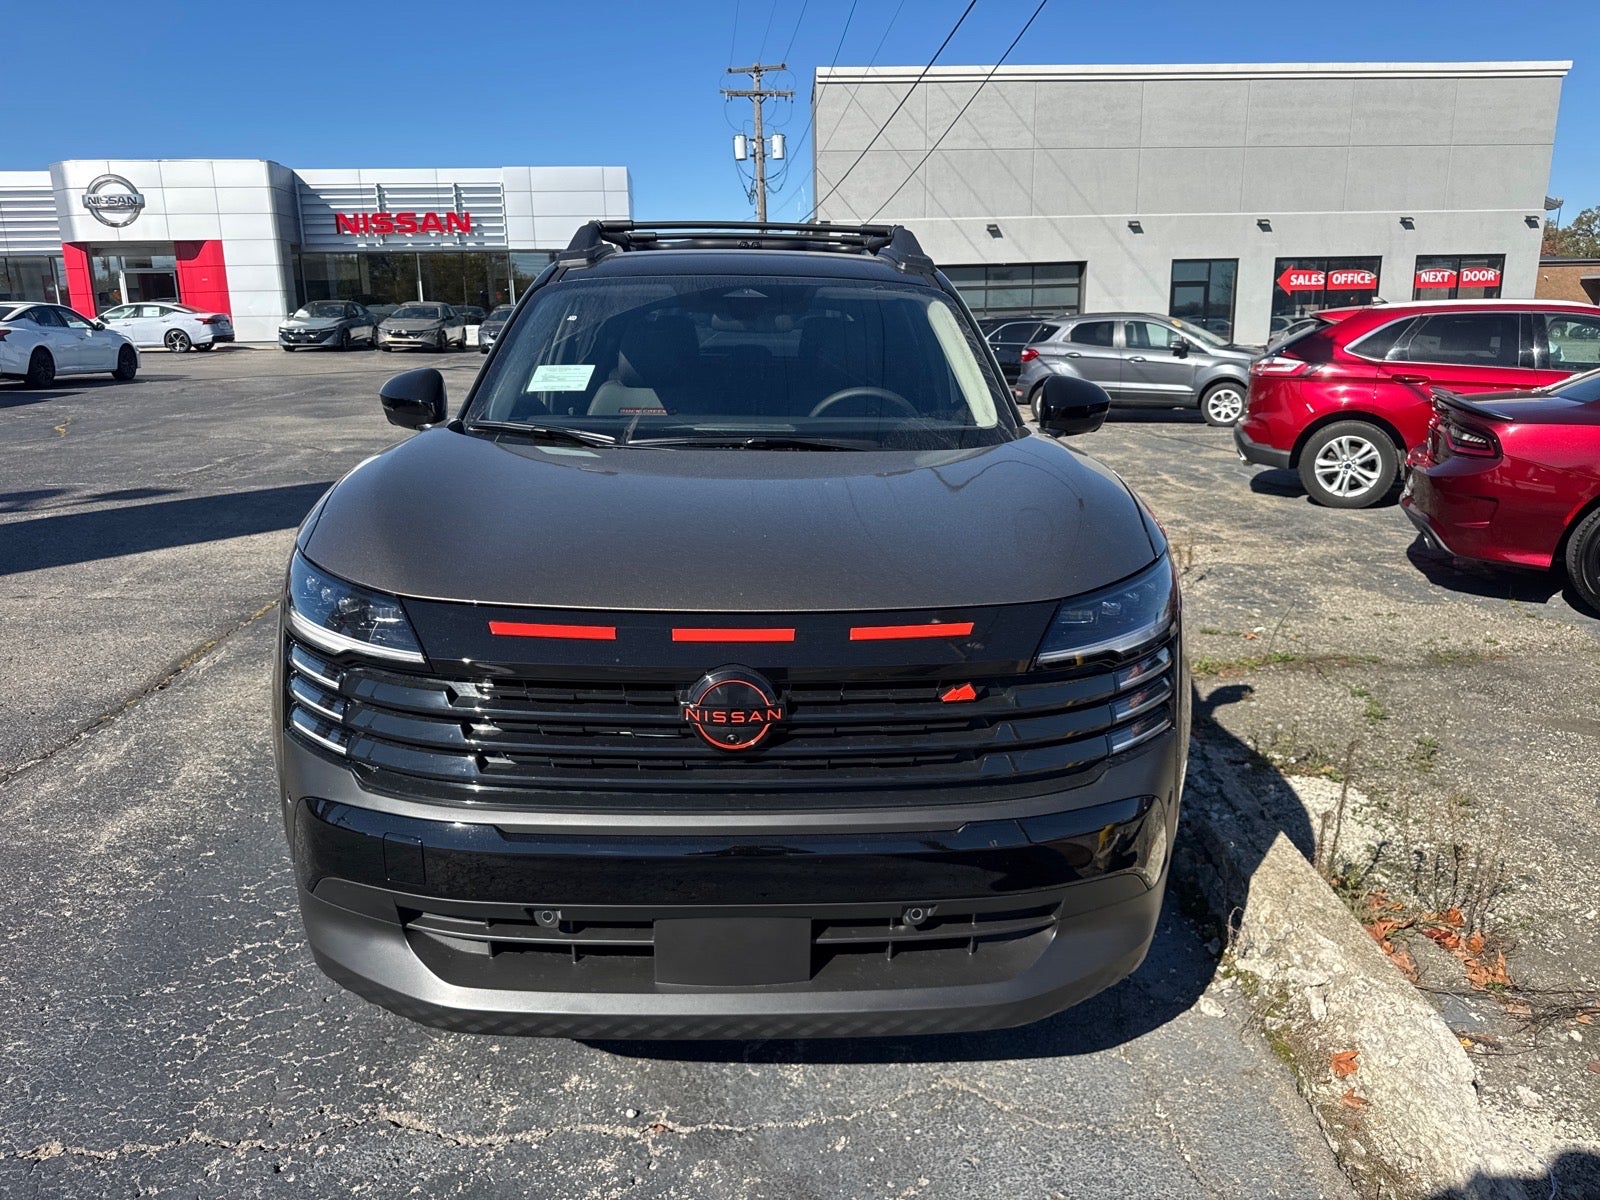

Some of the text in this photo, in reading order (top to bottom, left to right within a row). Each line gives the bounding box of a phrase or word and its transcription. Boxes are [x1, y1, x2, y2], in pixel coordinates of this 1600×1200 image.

[87, 196, 138, 205] NISSAN
[335, 211, 472, 235] NISSAN
[1290, 273, 1371, 286] SALES OFFICE
[1420, 270, 1495, 283] NEXT DOOR
[685, 708, 781, 723] NISSAN
